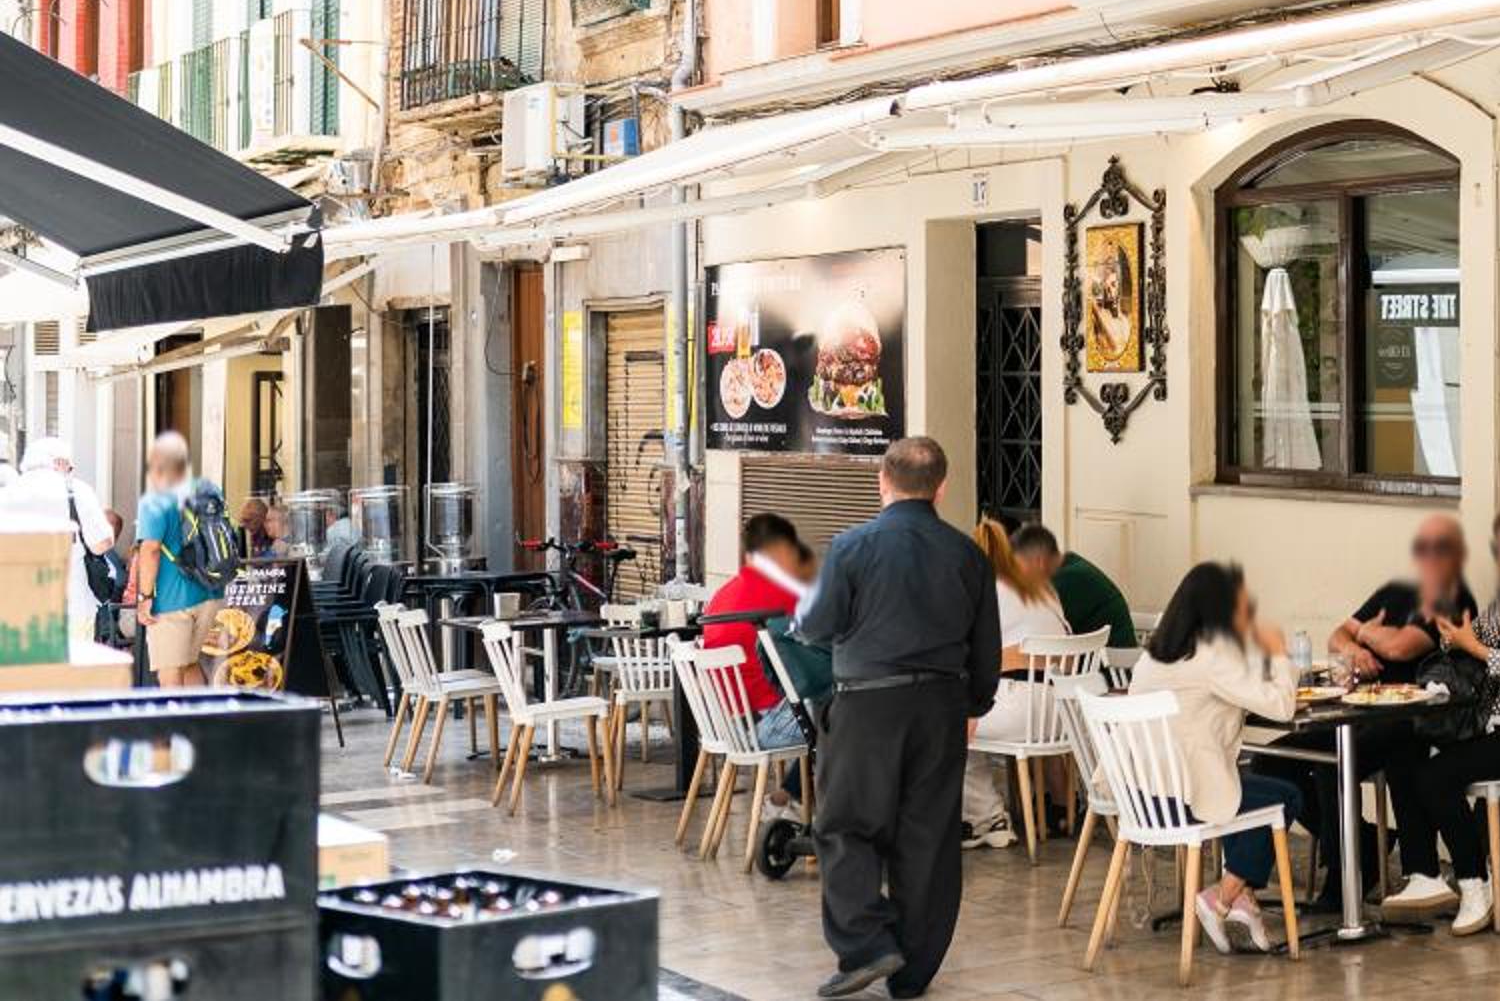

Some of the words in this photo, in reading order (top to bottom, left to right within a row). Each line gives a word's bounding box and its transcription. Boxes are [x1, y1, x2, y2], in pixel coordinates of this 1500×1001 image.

[226, 582, 287, 597] GENTINE
[227, 595, 266, 606] STEAK
[0, 874, 124, 923] ERVEZAS
[129, 863, 285, 910] ALHAMBRA
